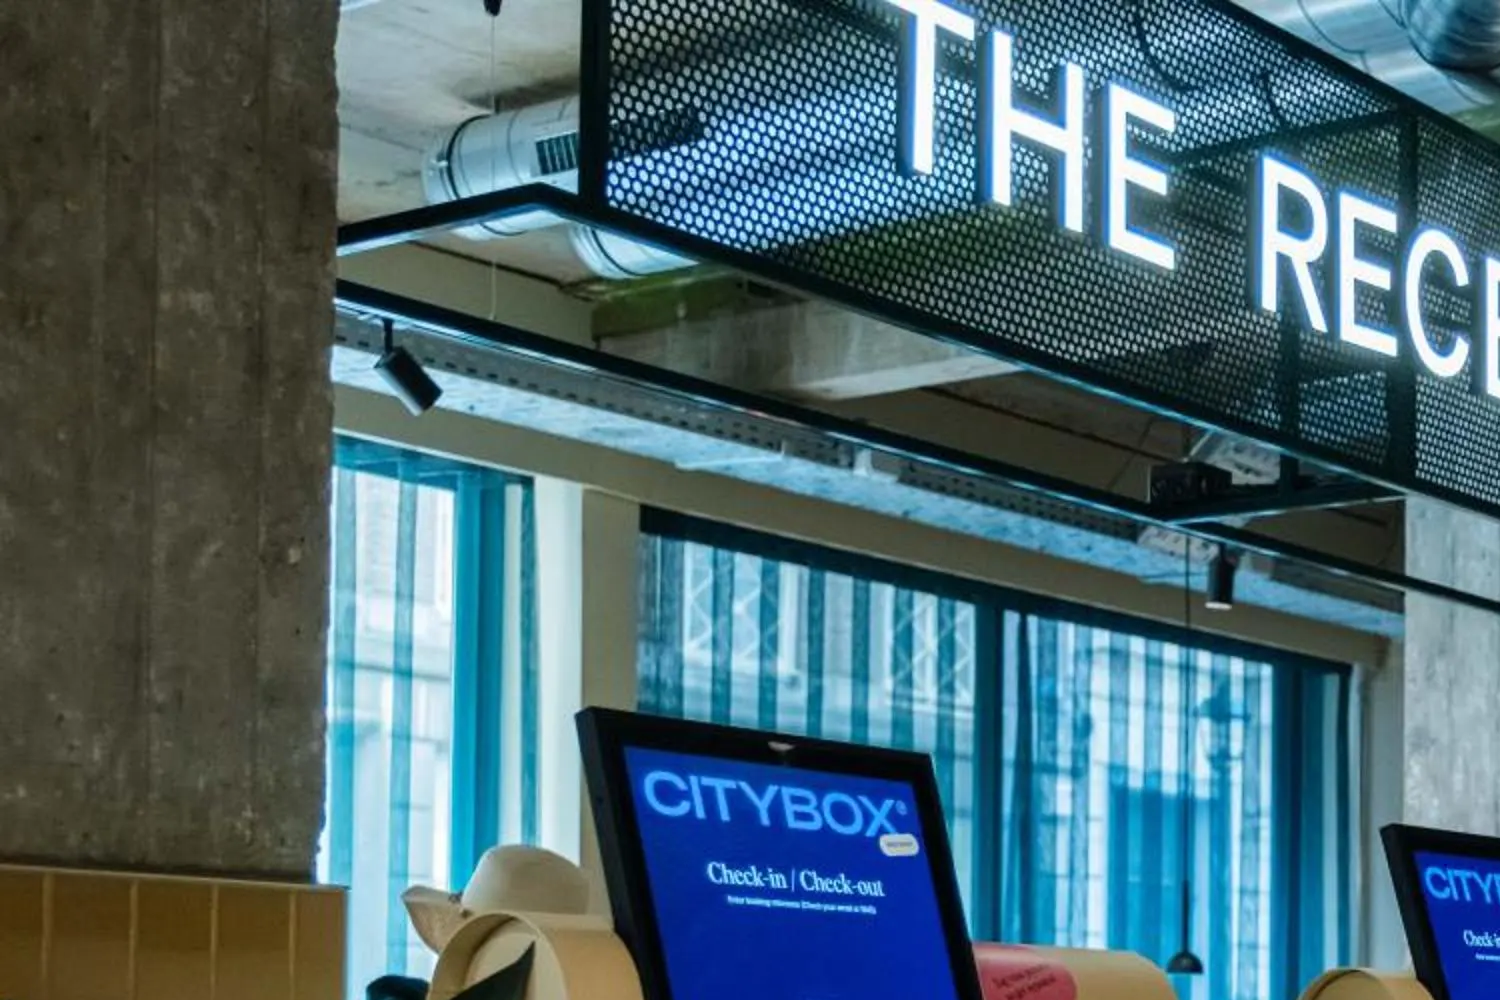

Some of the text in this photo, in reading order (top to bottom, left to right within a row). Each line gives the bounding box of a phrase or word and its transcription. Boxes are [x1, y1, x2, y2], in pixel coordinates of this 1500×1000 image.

[885, 0, 1176, 271] THE
[643, 770, 896, 837] CITYBOX
[705, 860, 788, 889] Check-in
[798, 869, 886, 897] Check-out
